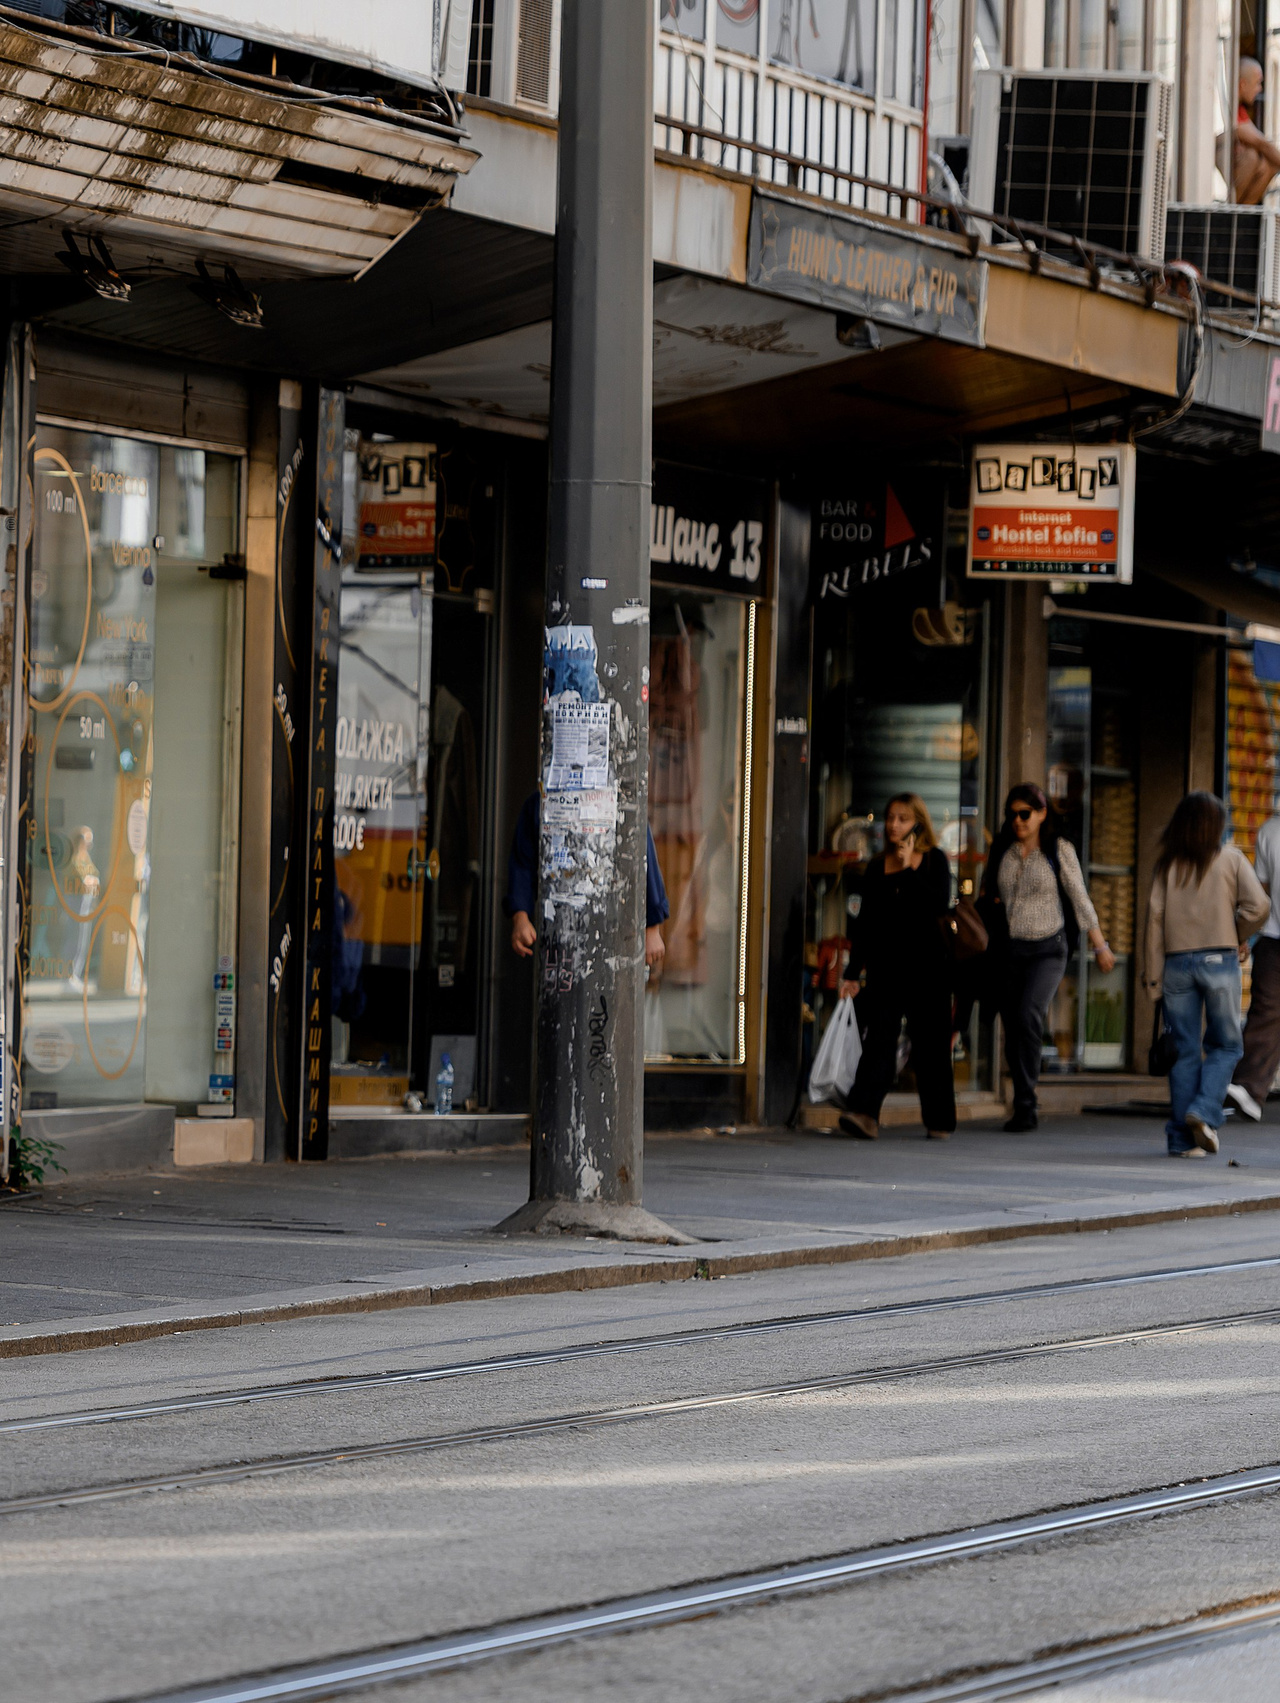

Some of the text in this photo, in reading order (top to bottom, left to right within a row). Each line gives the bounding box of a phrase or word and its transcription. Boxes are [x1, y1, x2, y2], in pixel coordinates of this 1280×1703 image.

[846, 243, 912, 305] LEATHER
[927, 266, 958, 318] FUR
[90, 464, 147, 497] Barcelona
[46, 489, 77, 514] 100 ml
[820, 499, 858, 517] BAR
[650, 503, 763, 582] Шанс 13
[820, 522, 873, 542] FOOD
[992, 525, 1098, 546] Hostel Sofia
[96, 611, 148, 642] New York
[315, 607, 330, 751] ЯКЕТА
[558, 702, 593, 710] РЕМОНТ
[80, 715, 105, 740] 50 ml
[336, 716, 404, 765] ОДАЖБА
[352, 774, 393, 810] ЯКЕТА
[311, 787, 325, 932] ПАЛТА
[308, 966, 323, 1141] КАШМИР
